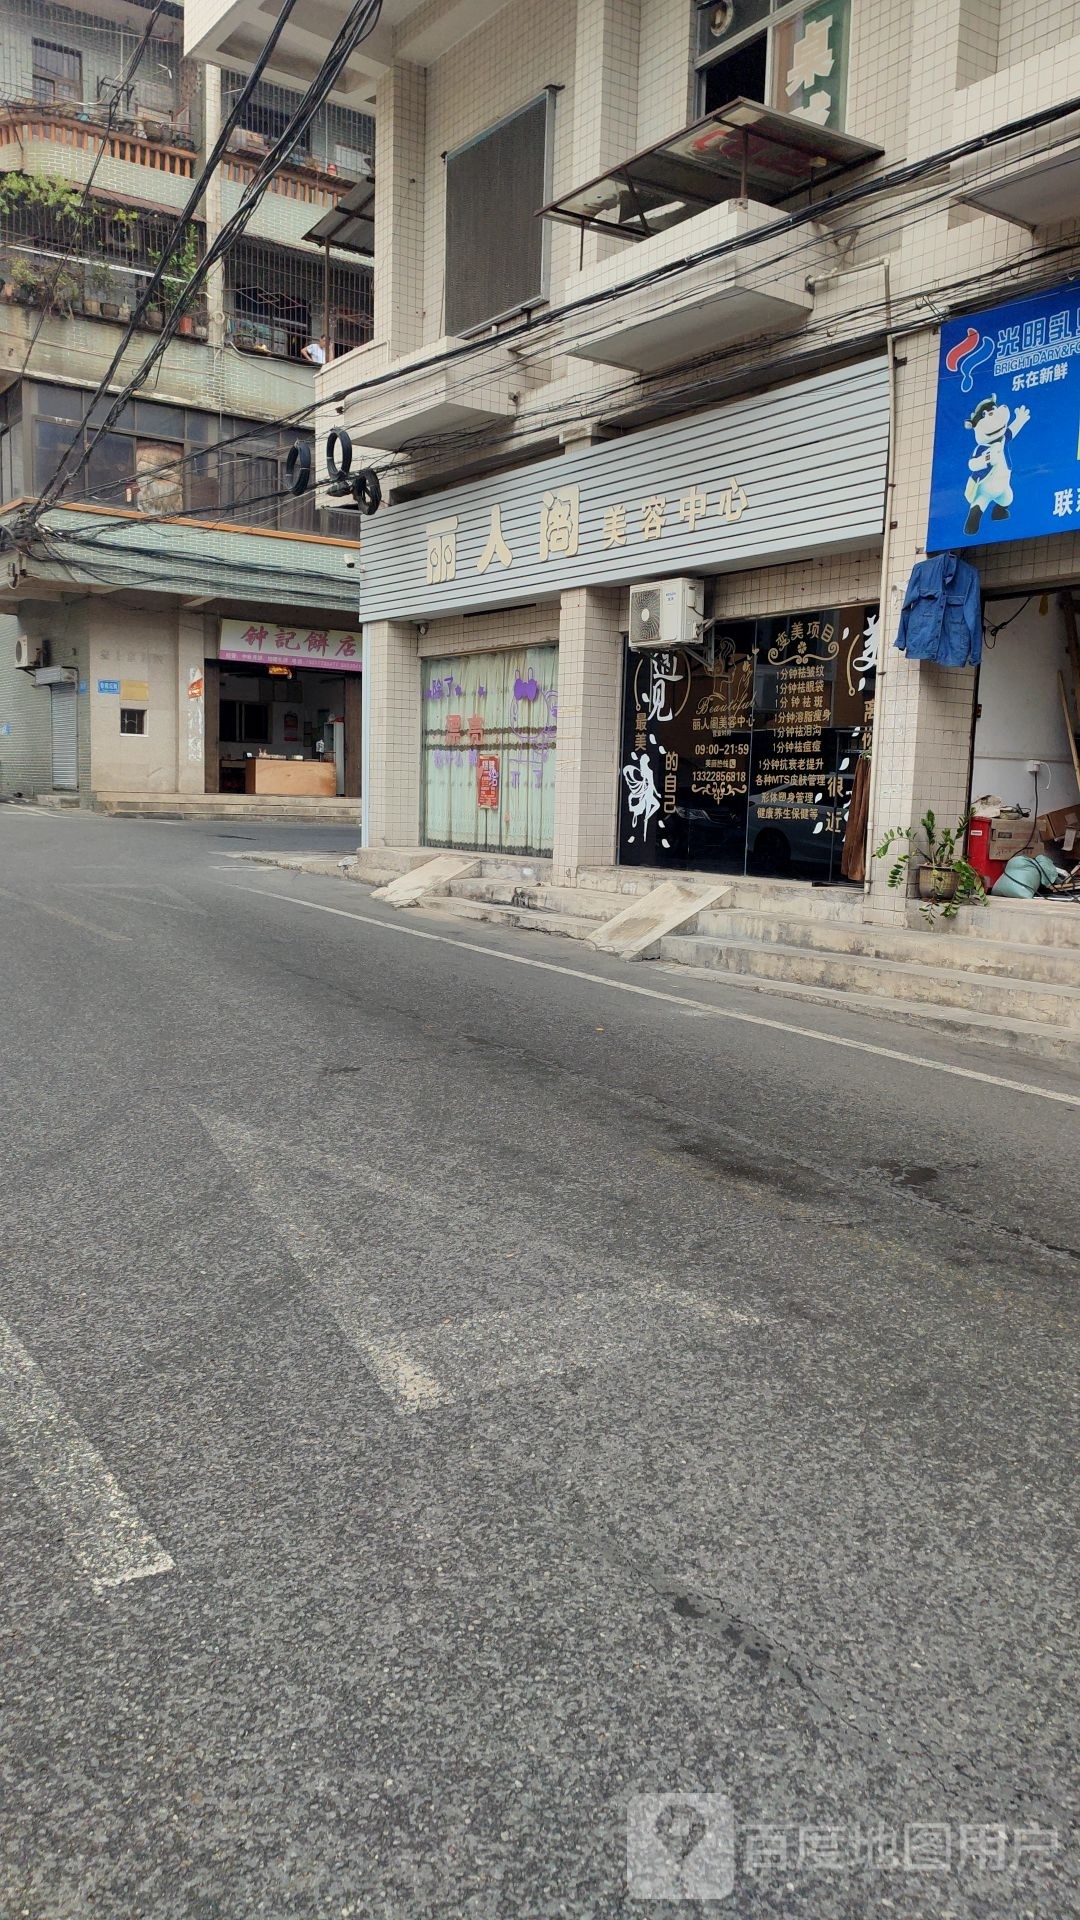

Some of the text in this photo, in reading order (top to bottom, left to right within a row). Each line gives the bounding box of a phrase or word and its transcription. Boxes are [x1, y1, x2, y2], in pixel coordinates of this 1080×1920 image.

[997, 307, 1080, 357] 光明乳
[994, 356, 1030, 377] BRIGHT
[1012, 362, 1068, 391] 乐在新鲜
[426, 476, 749, 584] 丽人阁 美容中心
[776, 621, 834, 652] 变美项目
[776, 680, 824, 694] 1分钟祛眼袋
[635, 713, 647, 751] 最美
[692, 715, 755, 730] 丽人阁美容中心
[759, 757, 824, 771] 1分钟抗衰老提升
[664, 751, 678, 813] 的自己
[692, 771, 746, 781] 13322856818
[756, 774, 826, 787] 各种MTS皮肤管理
[757, 808, 818, 820] 健康养生保健等
